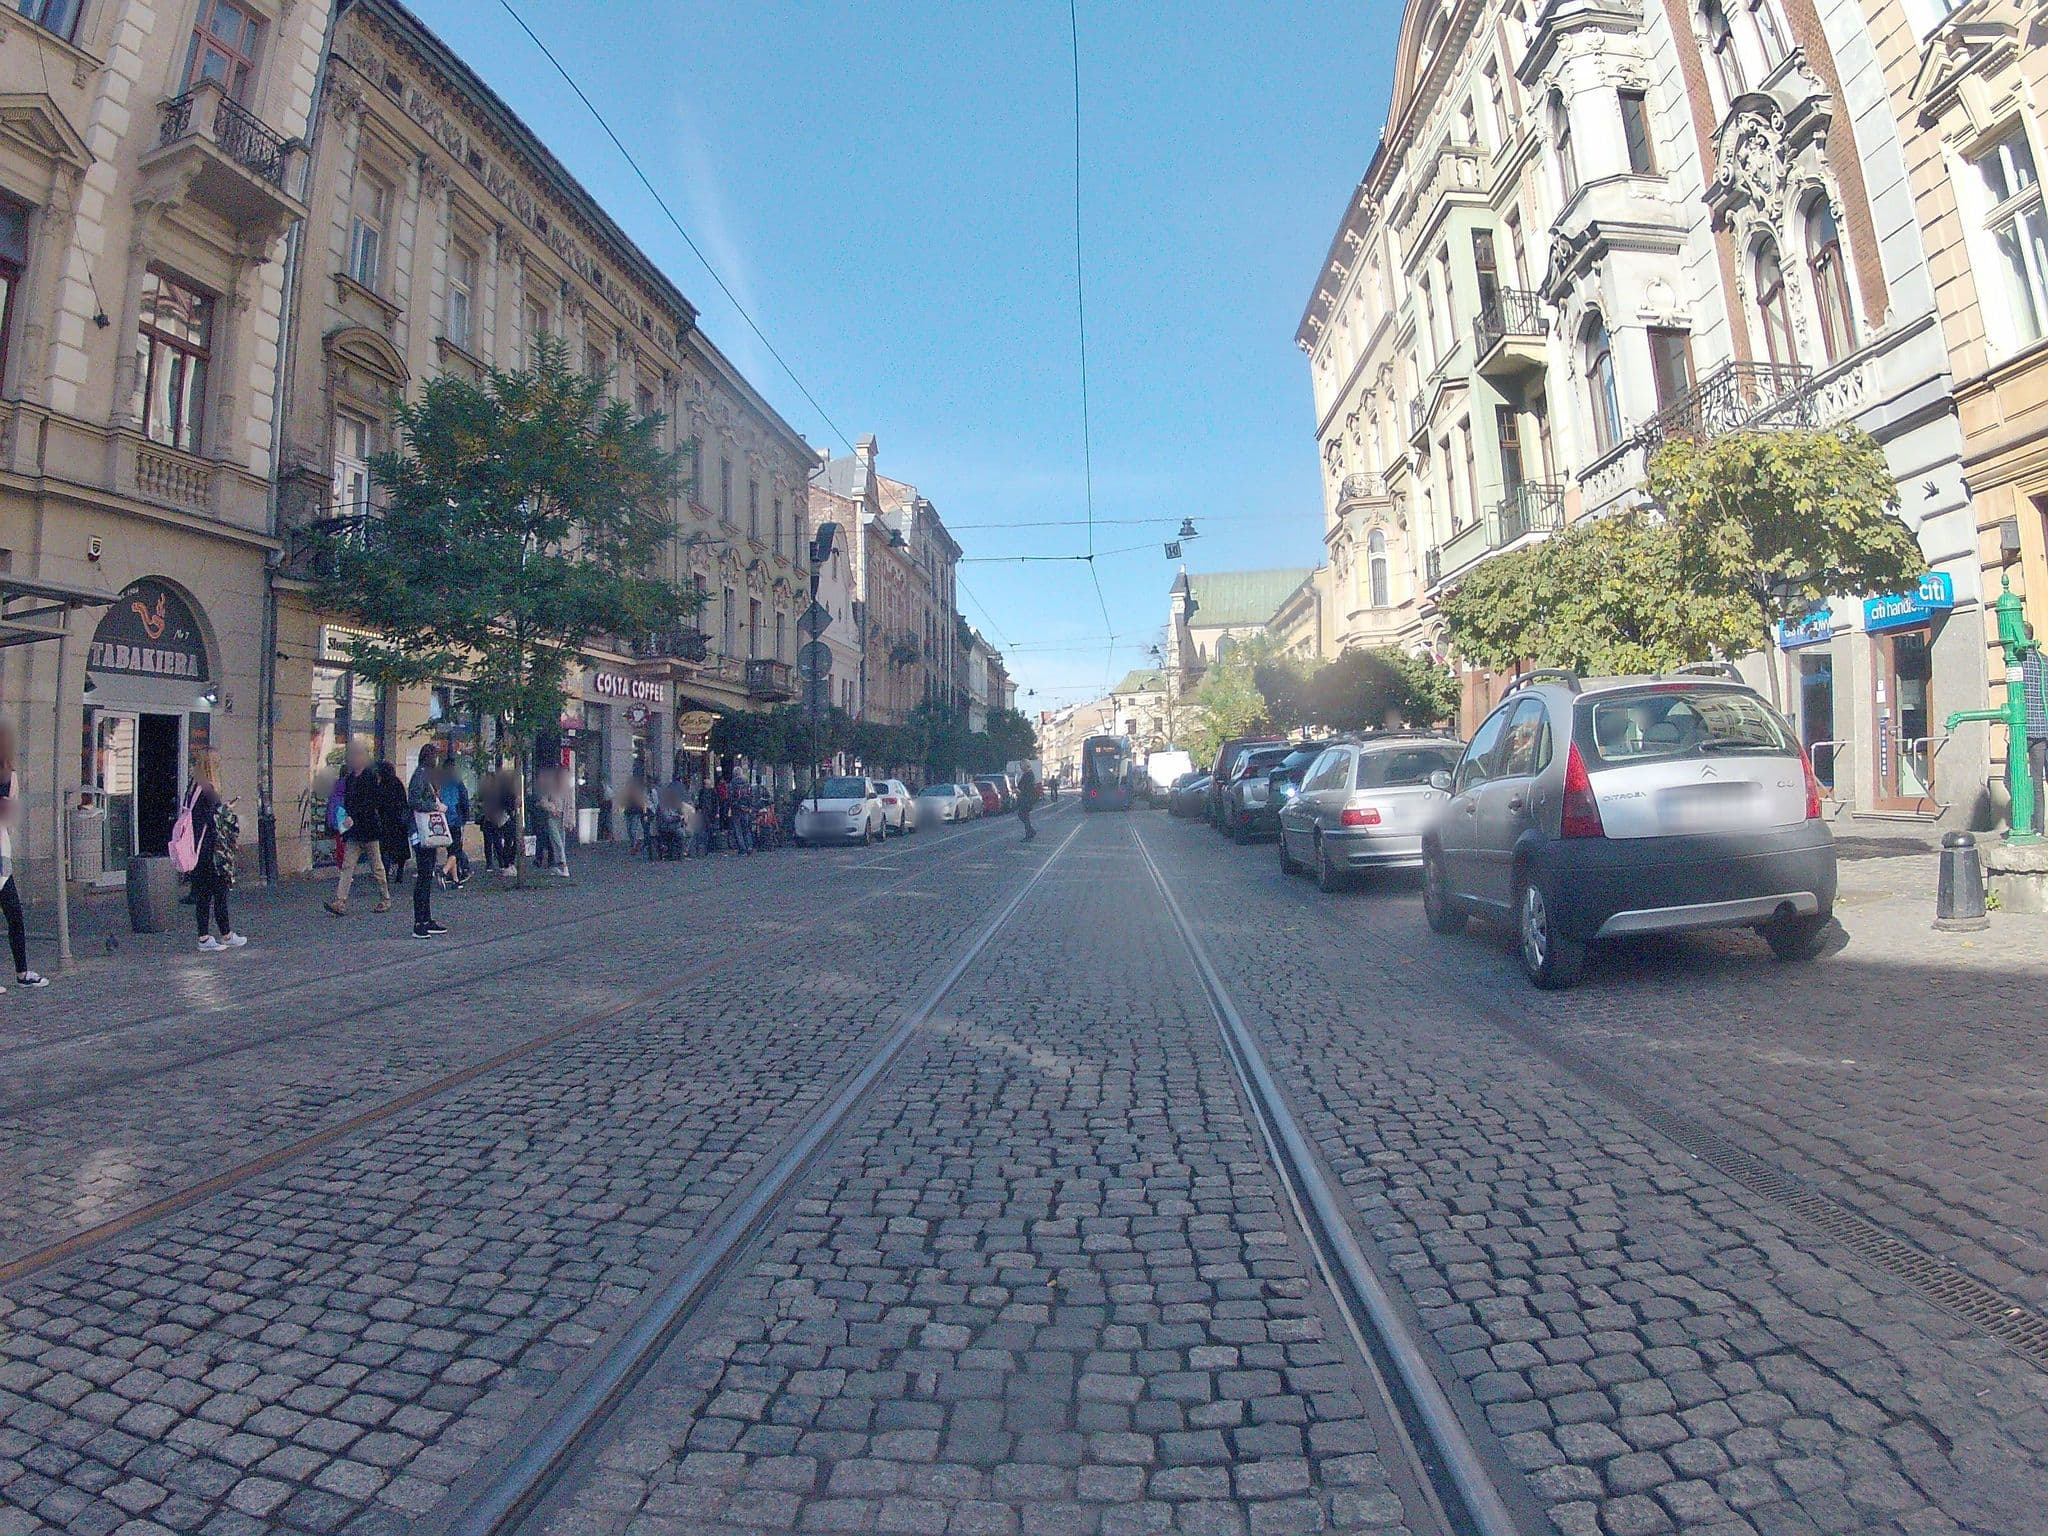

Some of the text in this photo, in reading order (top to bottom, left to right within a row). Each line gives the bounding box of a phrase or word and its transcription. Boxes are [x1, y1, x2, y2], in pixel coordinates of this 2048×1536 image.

[1167, 544, 1179, 557] 10
[1919, 581, 1945, 601] citi
[1871, 601, 1886, 620] citi
[91, 641, 199, 677] TABAKIERA
[597, 672, 664, 702] COSTA COFFEE
